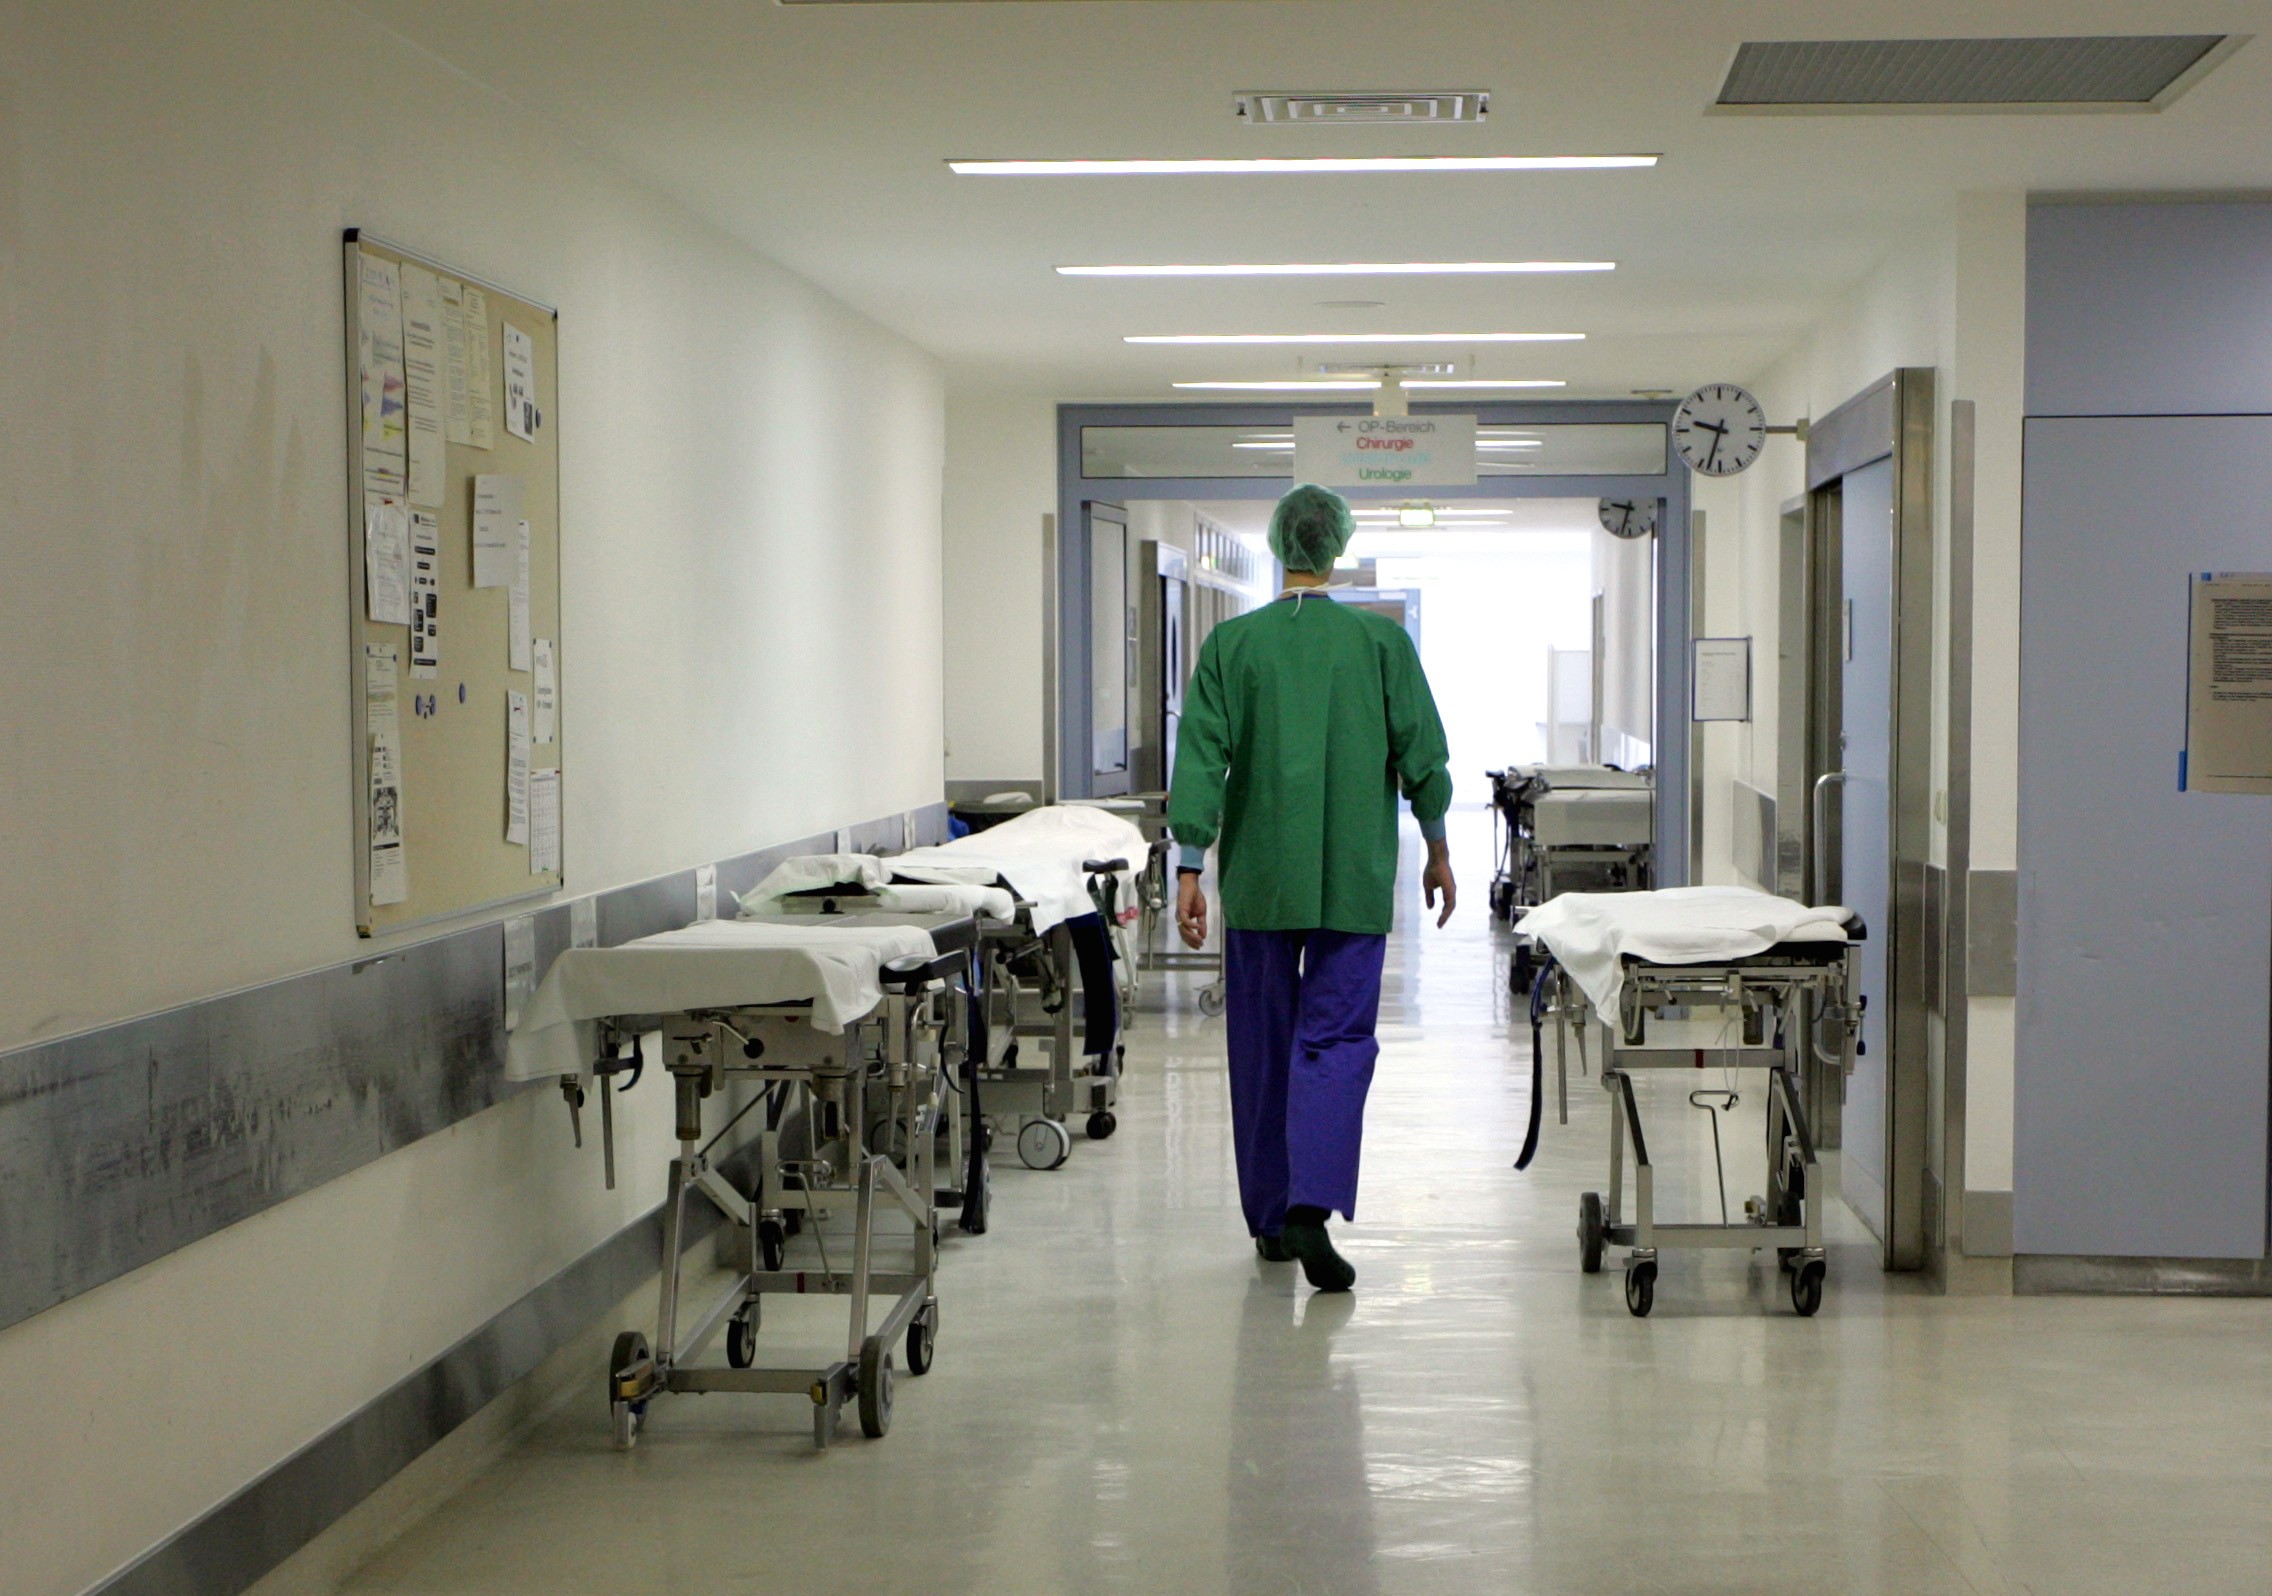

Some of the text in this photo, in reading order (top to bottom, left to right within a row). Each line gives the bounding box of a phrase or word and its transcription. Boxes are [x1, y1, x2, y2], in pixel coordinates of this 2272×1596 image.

[1358, 420, 1436, 433] OP-Bereich
[1356, 436, 1414, 452] Chirurgie
[1359, 467, 1411, 482] Urologie
